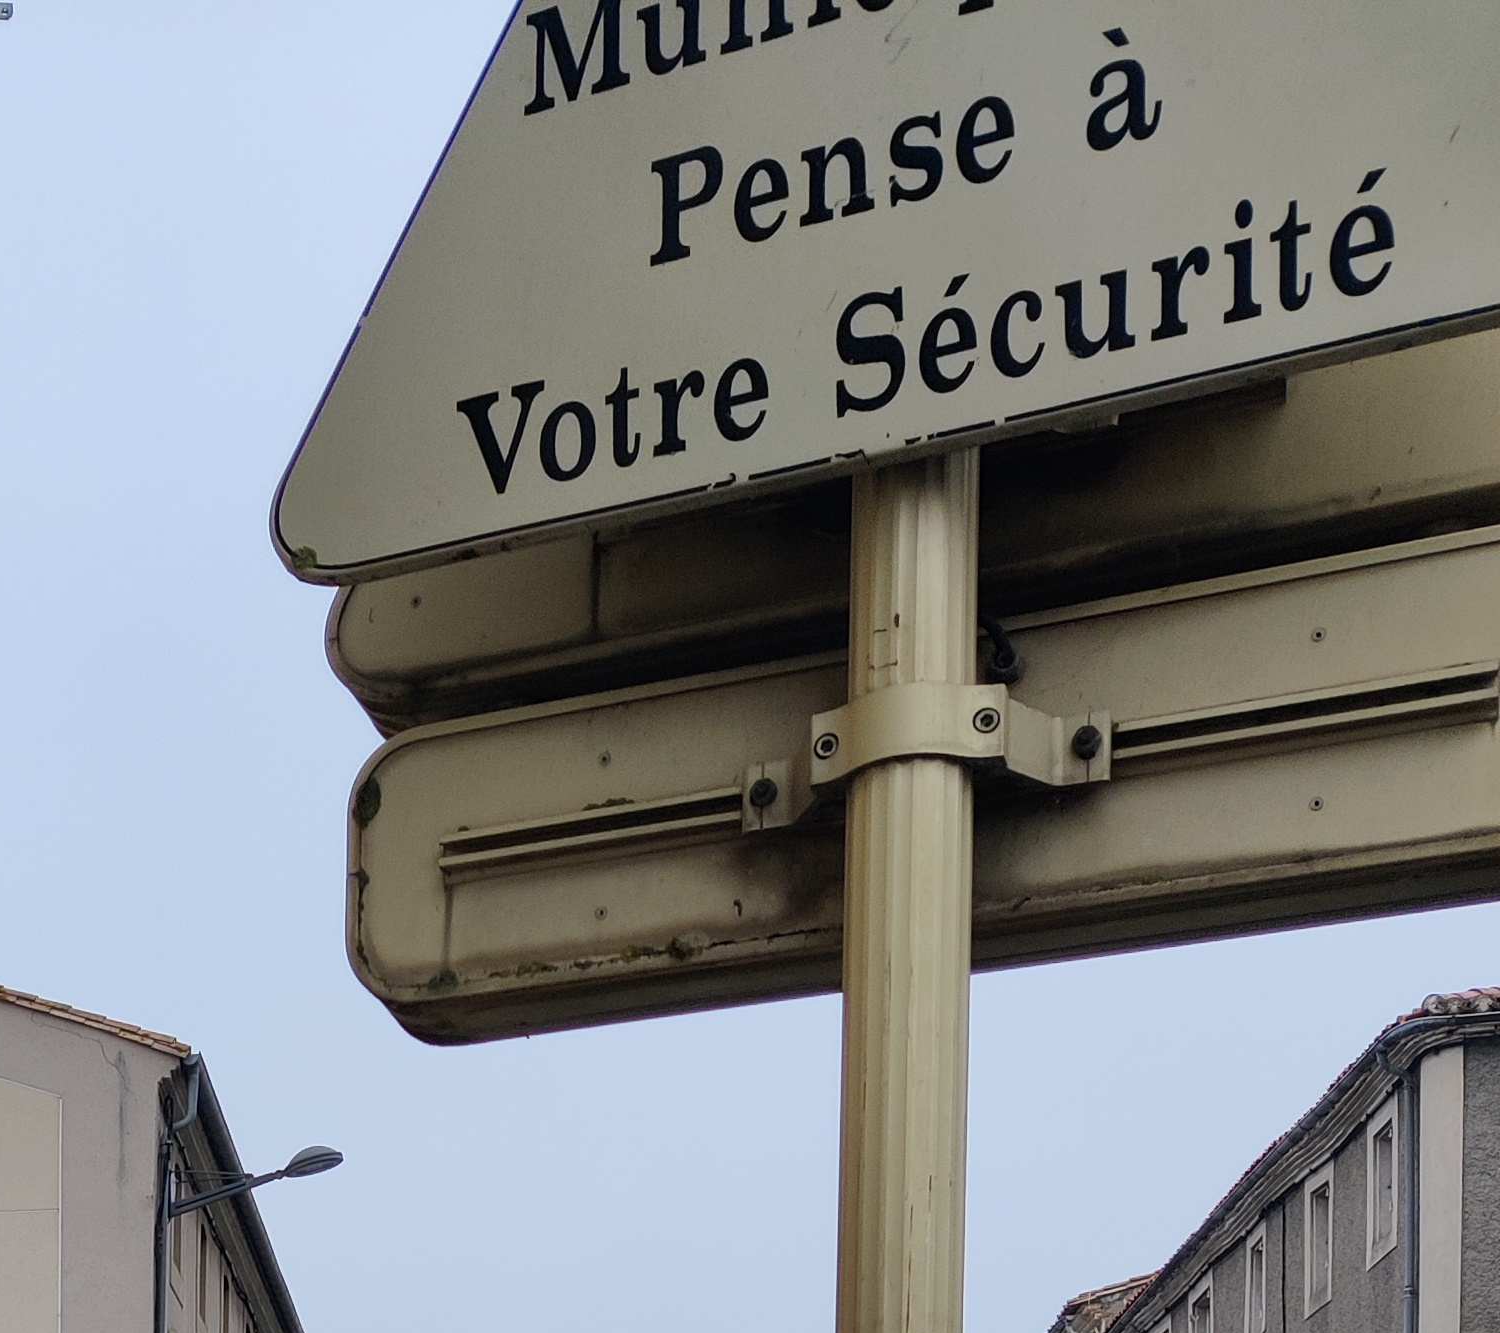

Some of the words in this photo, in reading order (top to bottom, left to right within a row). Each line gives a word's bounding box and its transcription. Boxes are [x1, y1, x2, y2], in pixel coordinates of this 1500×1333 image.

[650, 96, 1014, 267] Pense
[1087, 27, 1162, 151] à
[457, 358, 768, 494] Votre
[836, 167, 1394, 418] Sécurité
